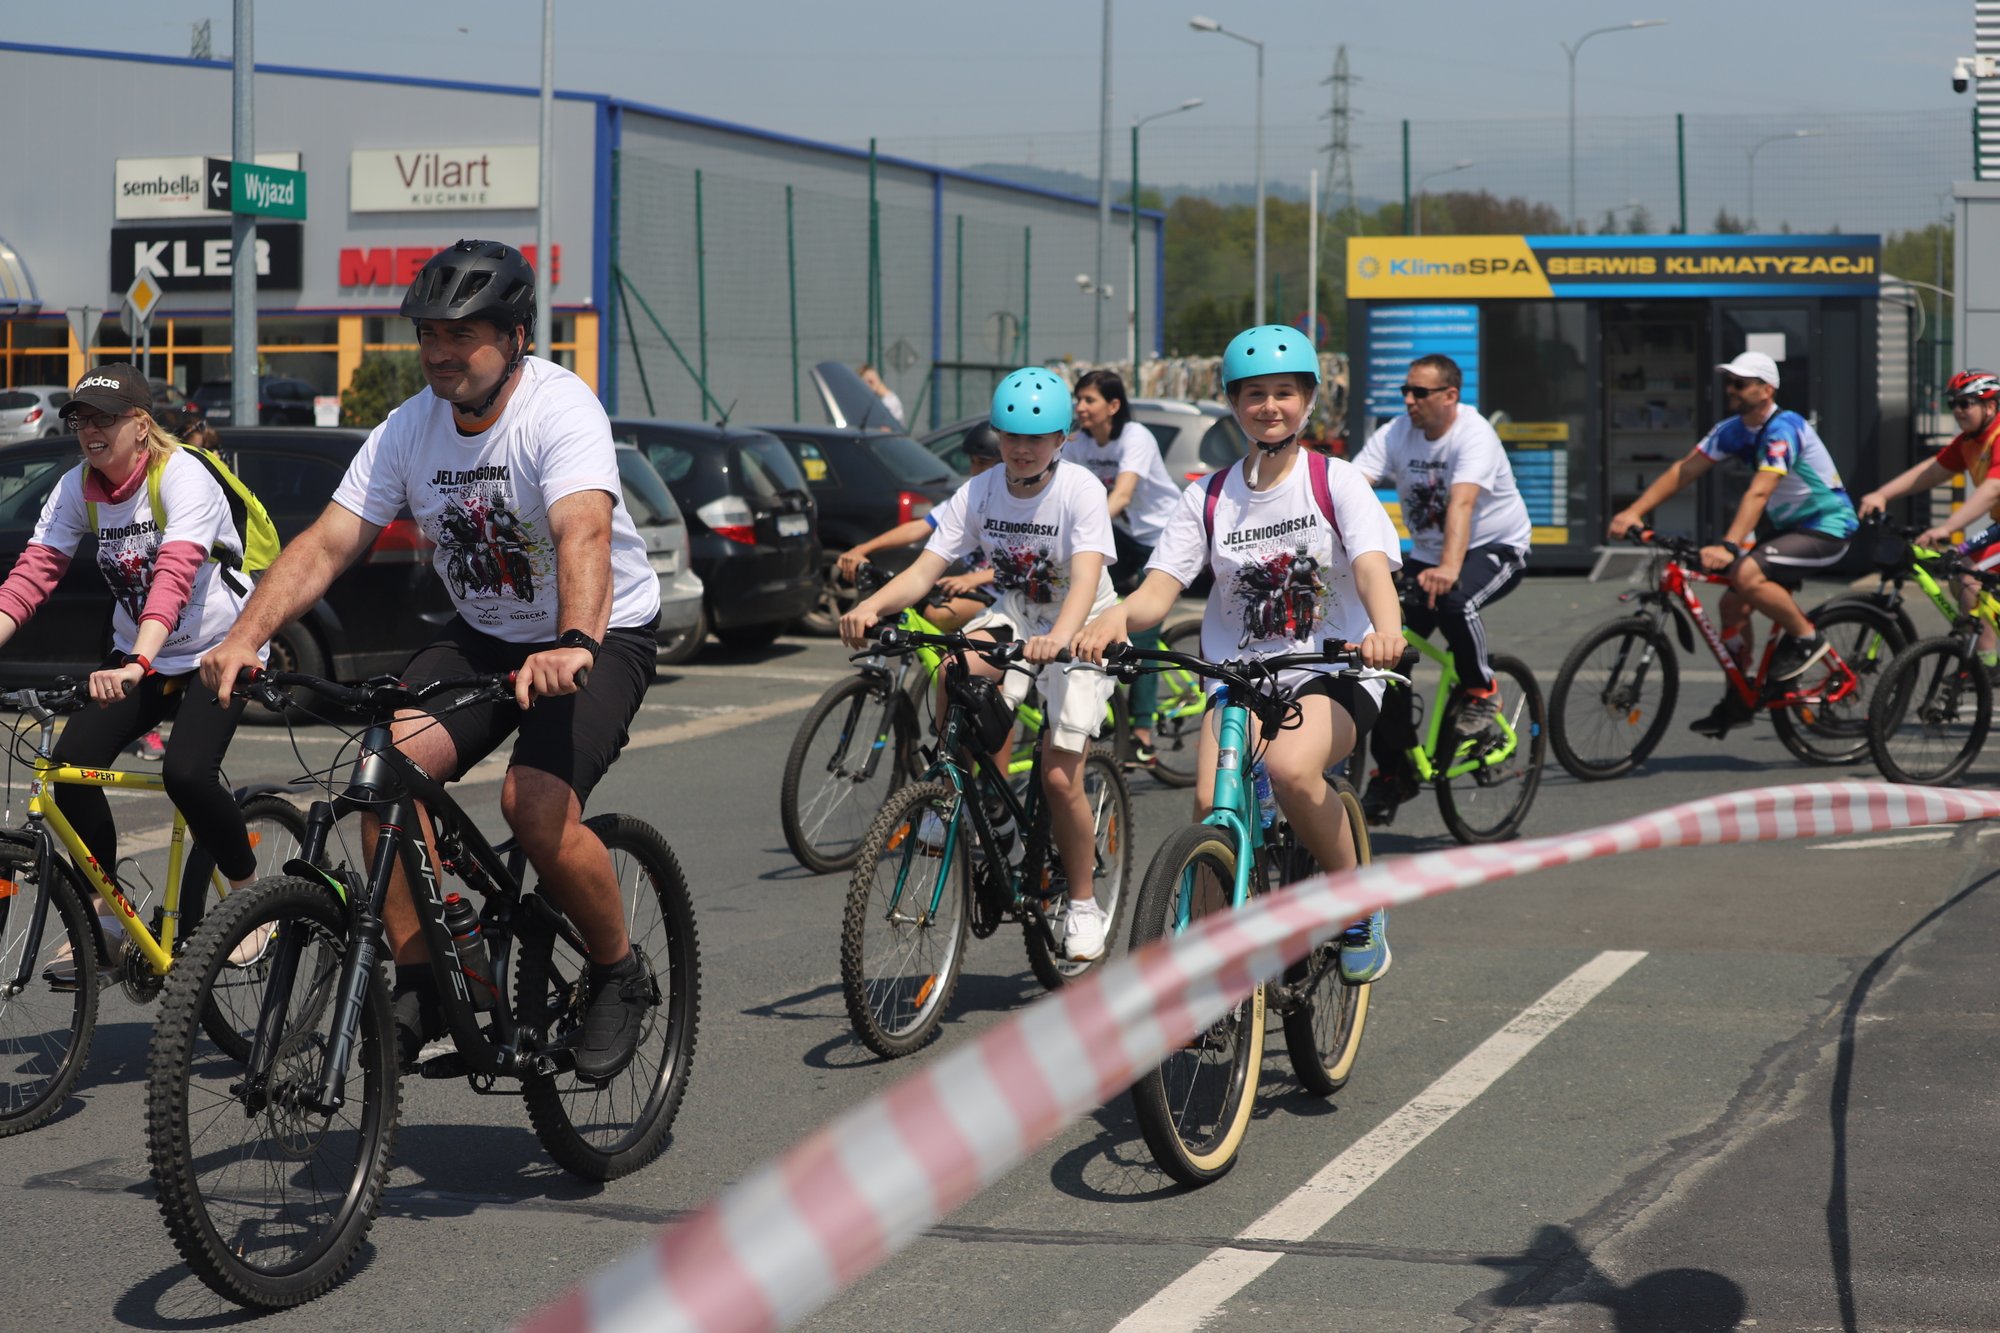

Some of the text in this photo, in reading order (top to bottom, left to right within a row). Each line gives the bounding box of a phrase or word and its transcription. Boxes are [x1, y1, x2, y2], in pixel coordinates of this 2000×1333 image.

[395, 153, 491, 188] Vilart
[123, 175, 200, 196] sembella
[244, 172, 295, 208] Wyjazd
[411, 192, 488, 205] KUCHNIE
[1389, 257, 1532, 275] KlimaSPA
[1547, 256, 1874, 274] SERWIS KLIMATYZACJI
[75, 375, 120, 394] adidas
[1223, 514, 1317, 545] JELENIOGÓRSKA
[80, 769, 115, 781] EXPERT
[413, 839, 471, 1002] WHYTE
